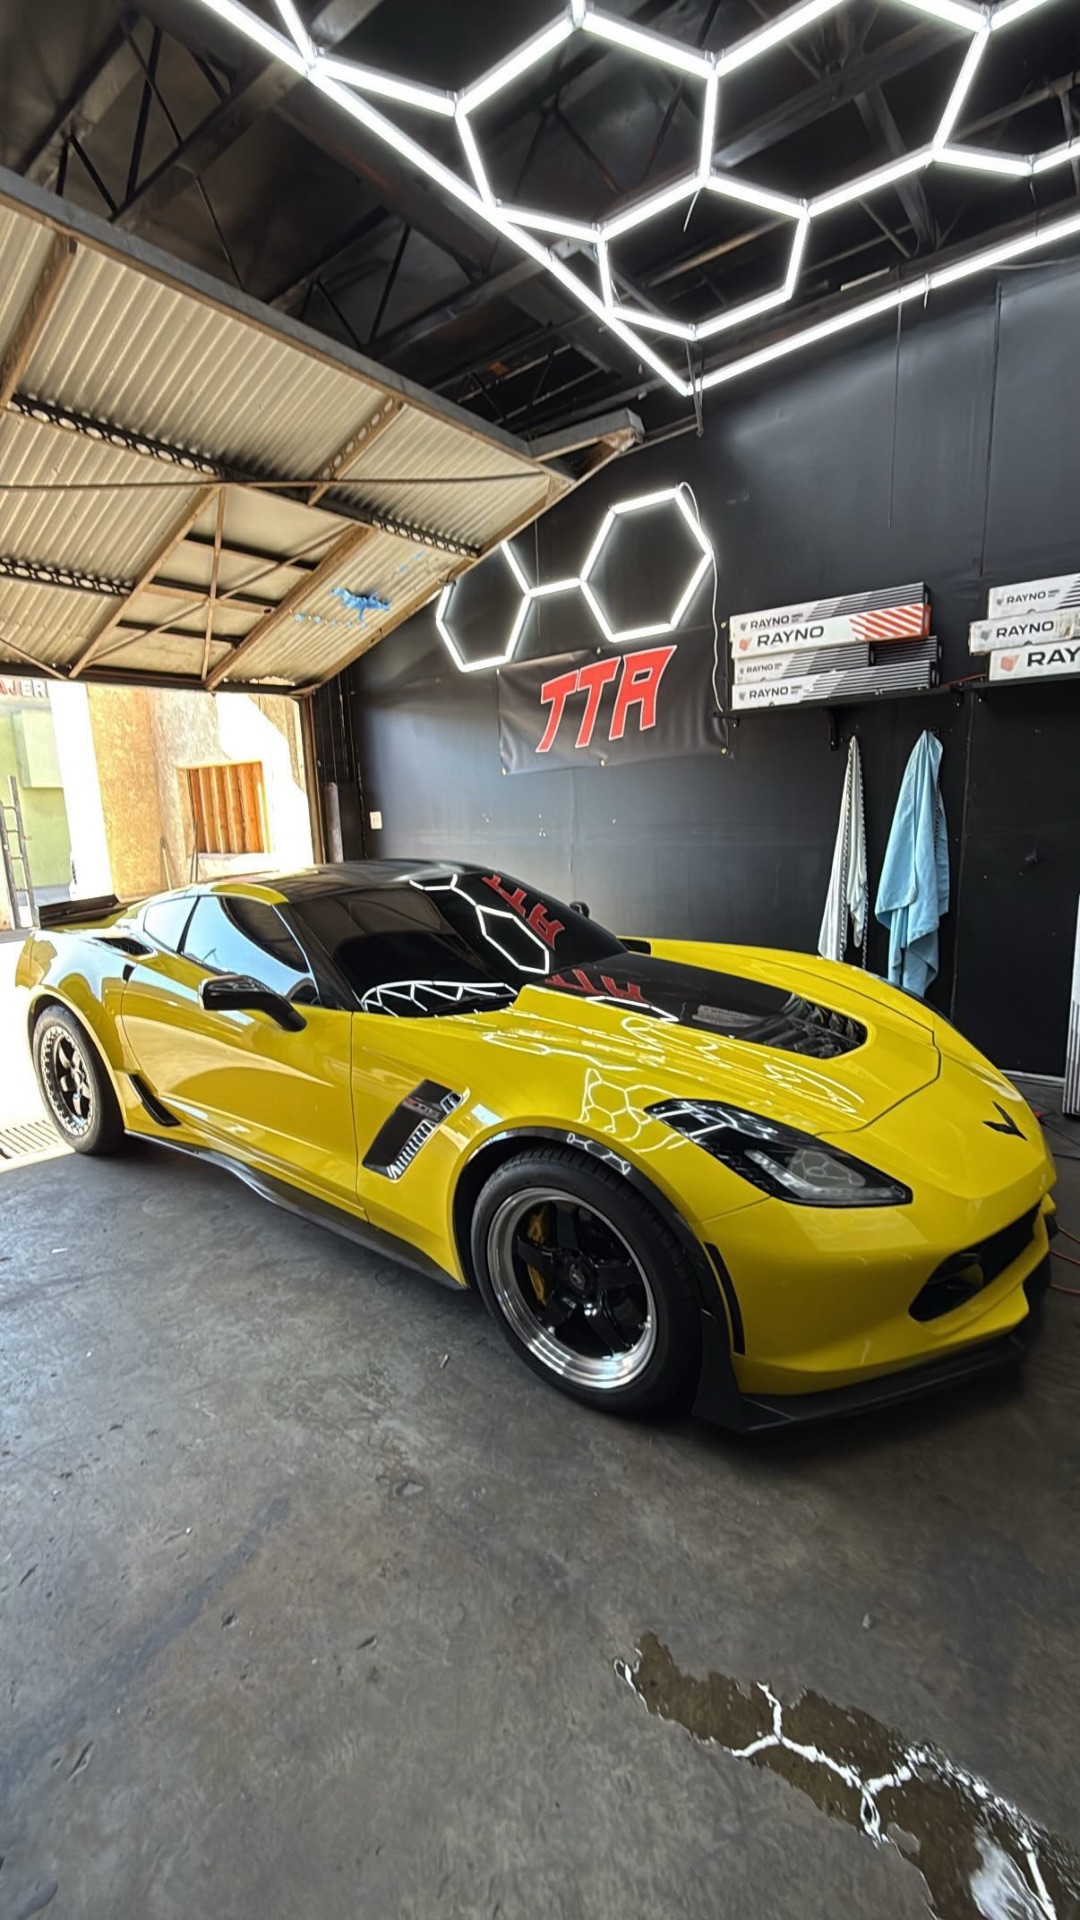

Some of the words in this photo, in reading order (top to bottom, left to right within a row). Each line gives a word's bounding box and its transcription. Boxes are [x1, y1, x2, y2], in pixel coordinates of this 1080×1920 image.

[1007, 591, 1046, 604] RAYNO
[750, 615, 790, 629] RAYNO
[996, 620, 1054, 638] RAYNO
[757, 625, 824, 647] RAYNO
[746, 663, 774, 674] RAYNO
[535, 645, 677, 753] TTA
[749, 686, 789, 699] RAYNO
